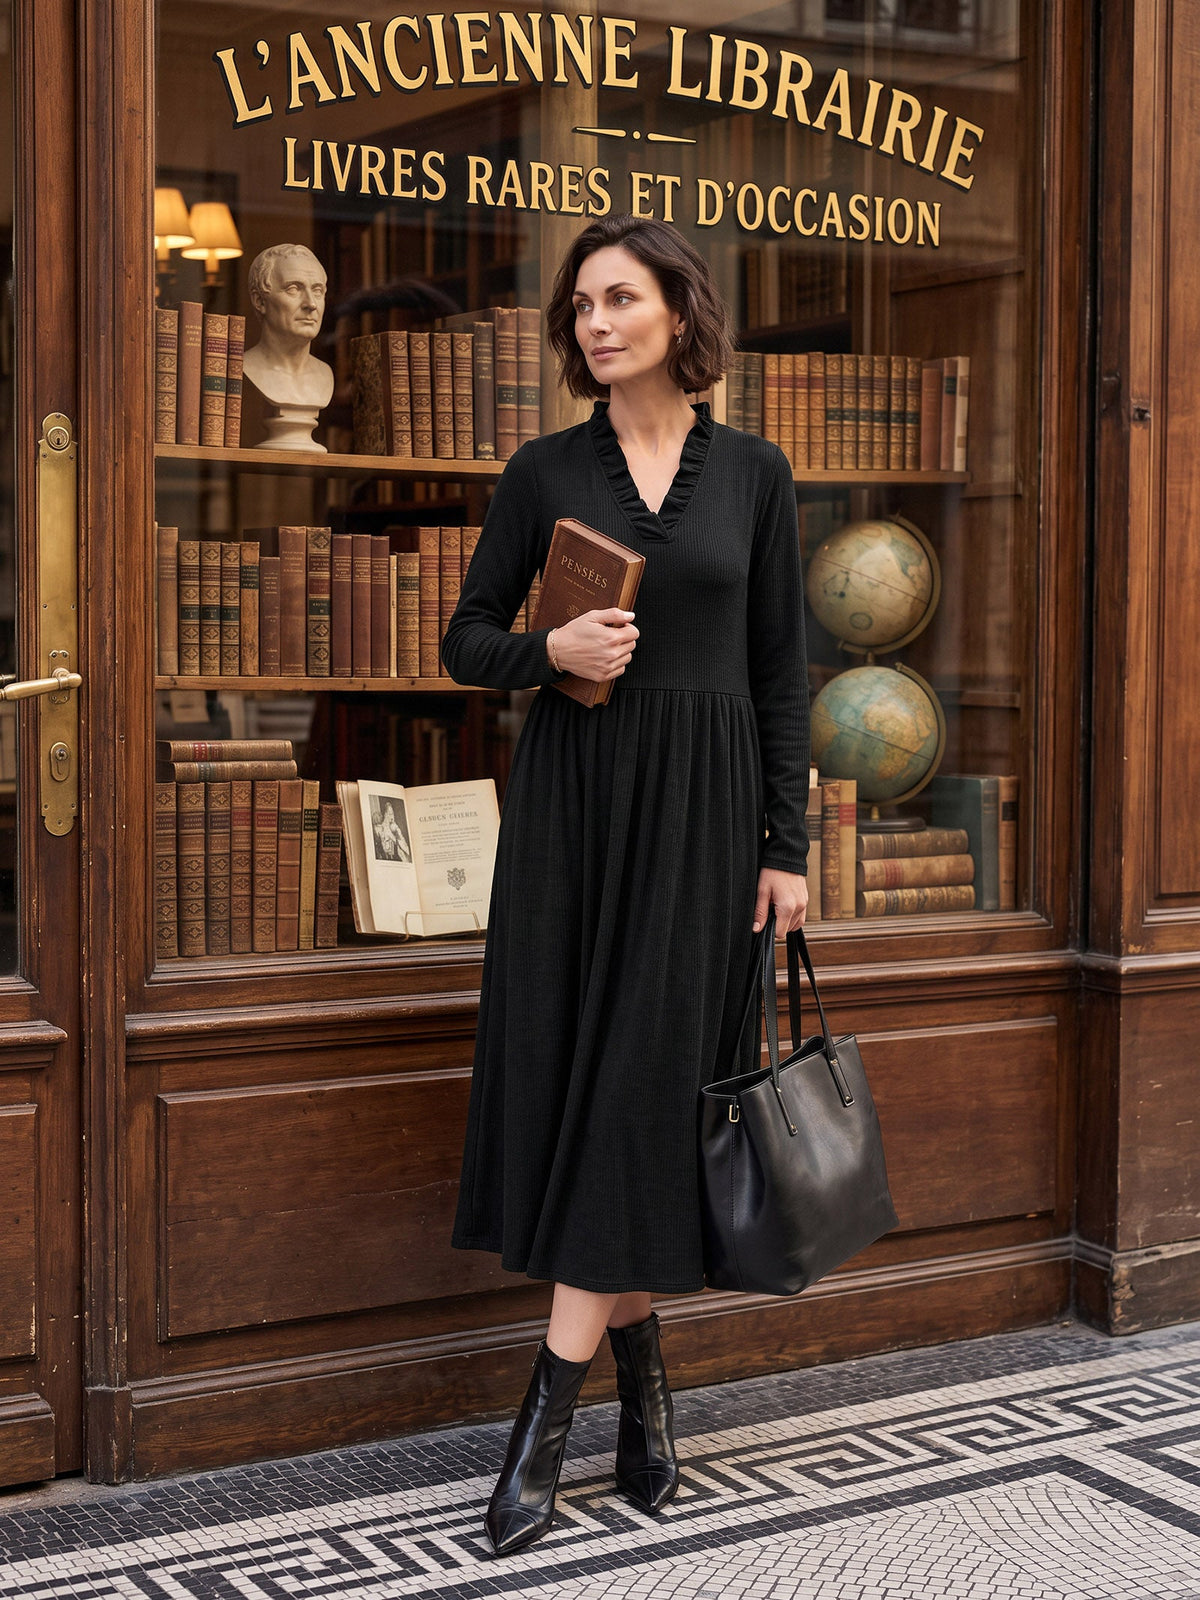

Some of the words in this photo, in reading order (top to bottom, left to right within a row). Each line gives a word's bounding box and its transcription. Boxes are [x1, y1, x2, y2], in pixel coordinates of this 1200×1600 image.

[216, 12, 639, 128] L’ANCIENNE
[663, 26, 984, 194] LIBRAIRIE
[284, 137, 447, 201] LIVRES
[467, 155, 612, 216] RARES
[630, 171, 681, 222] ET
[697, 178, 941, 246] D’OCCASION
[561, 554, 608, 589] PENSÉES
